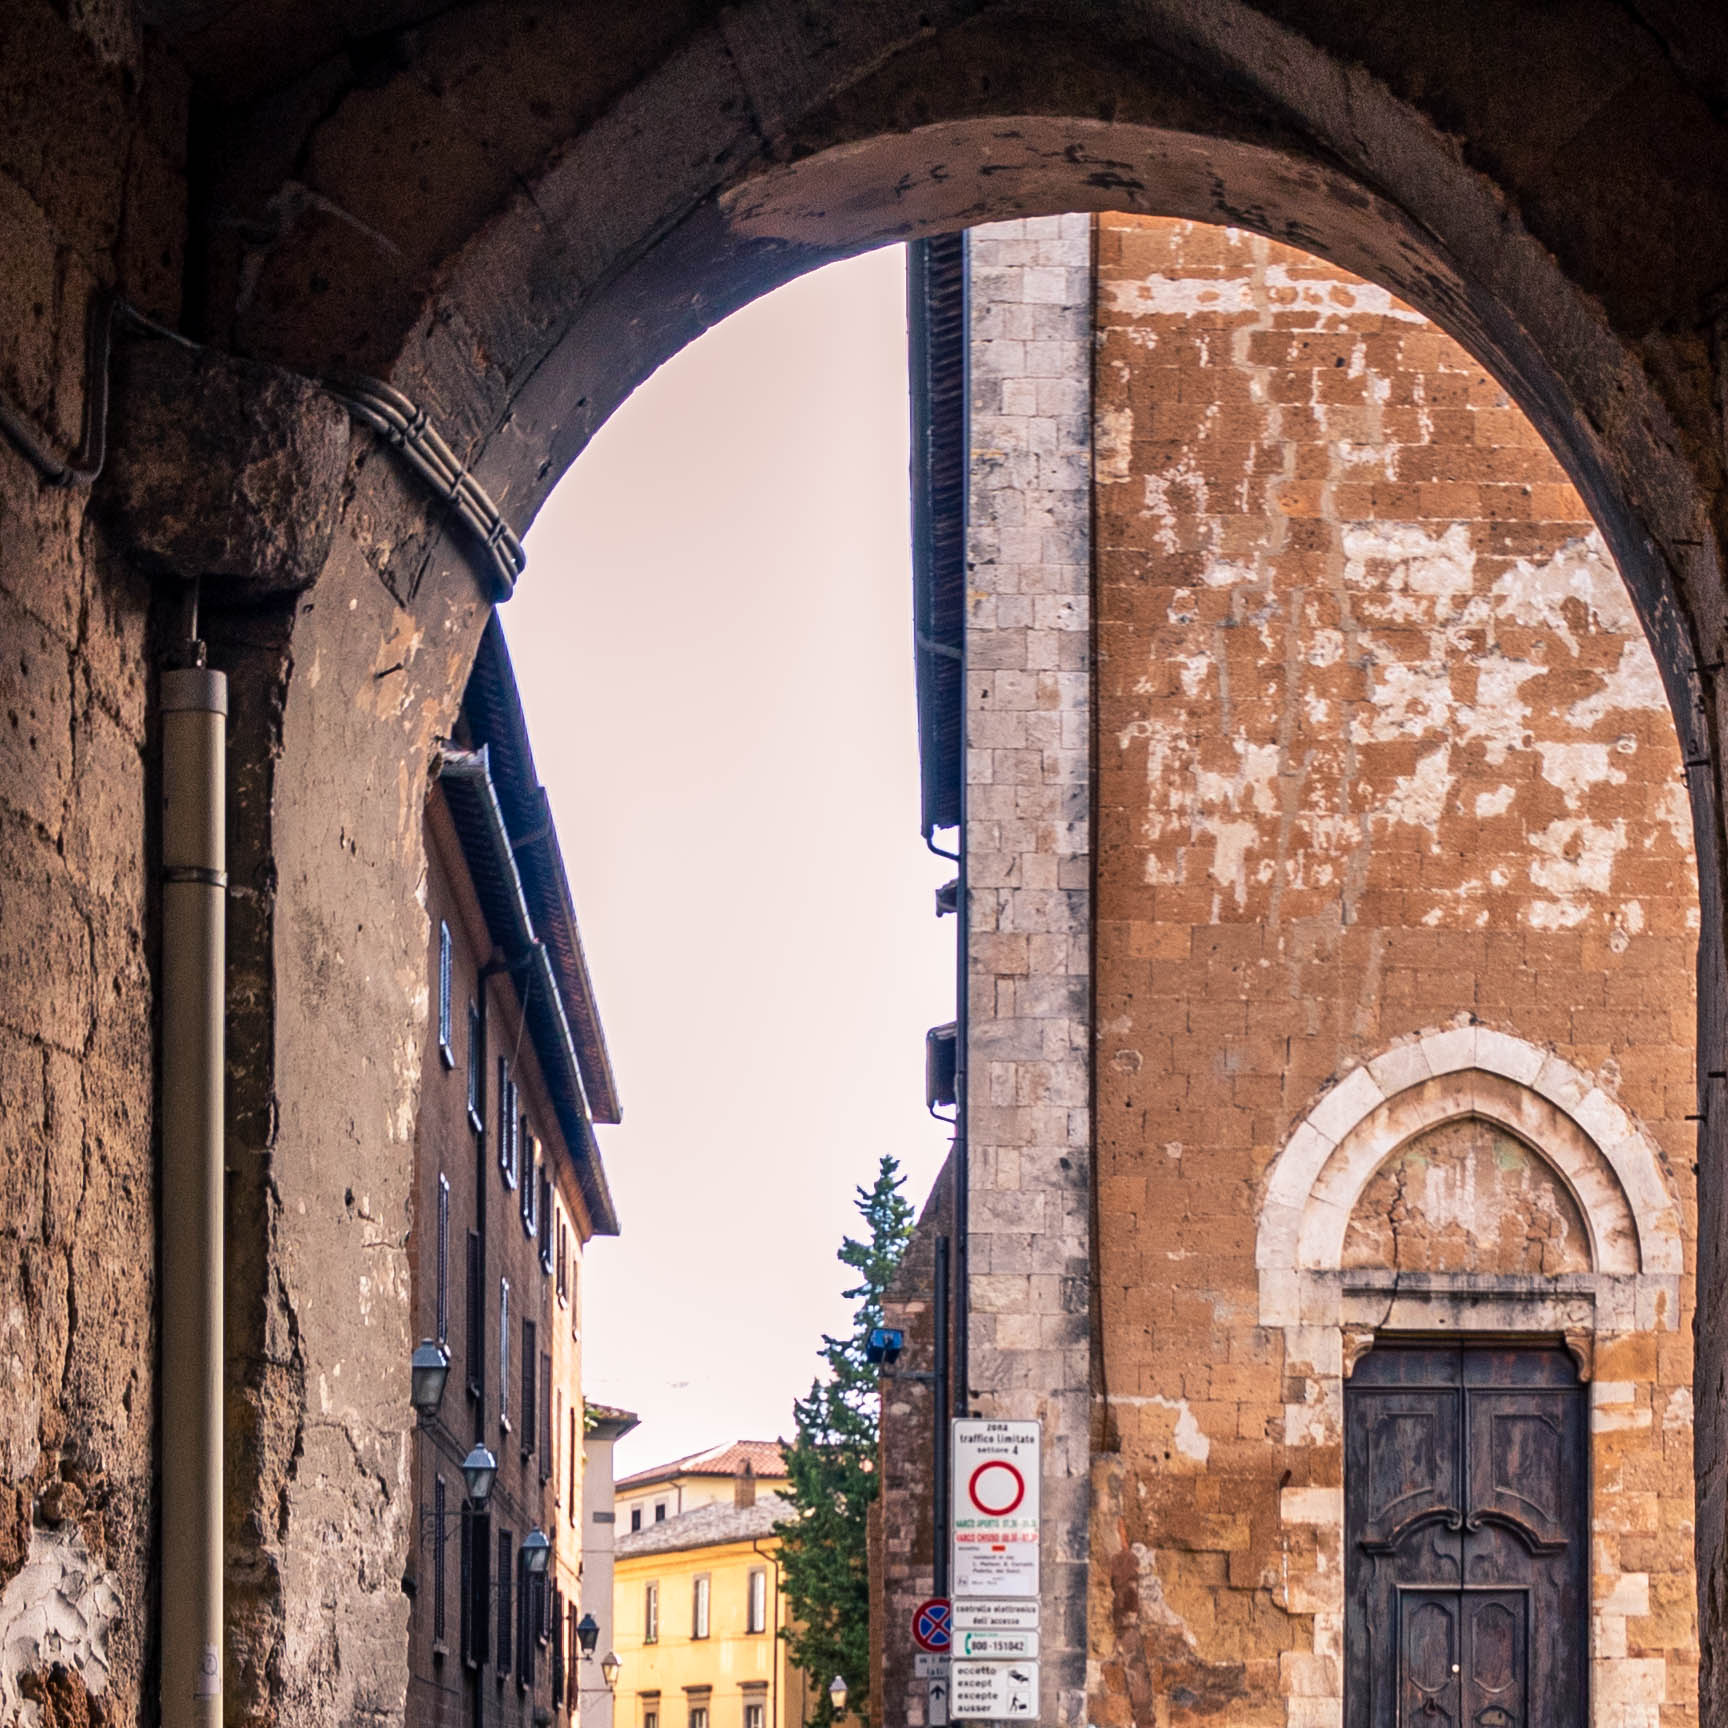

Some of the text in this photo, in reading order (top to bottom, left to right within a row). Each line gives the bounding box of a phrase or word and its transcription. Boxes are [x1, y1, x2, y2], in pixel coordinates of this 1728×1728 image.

[960, 1434, 1034, 1443] traffico limitato
[1013, 1445, 1018, 1455] 4
[958, 1666, 996, 1675] eccetto
[958, 1680, 992, 1689] except
[958, 1692, 998, 1701] excepte
